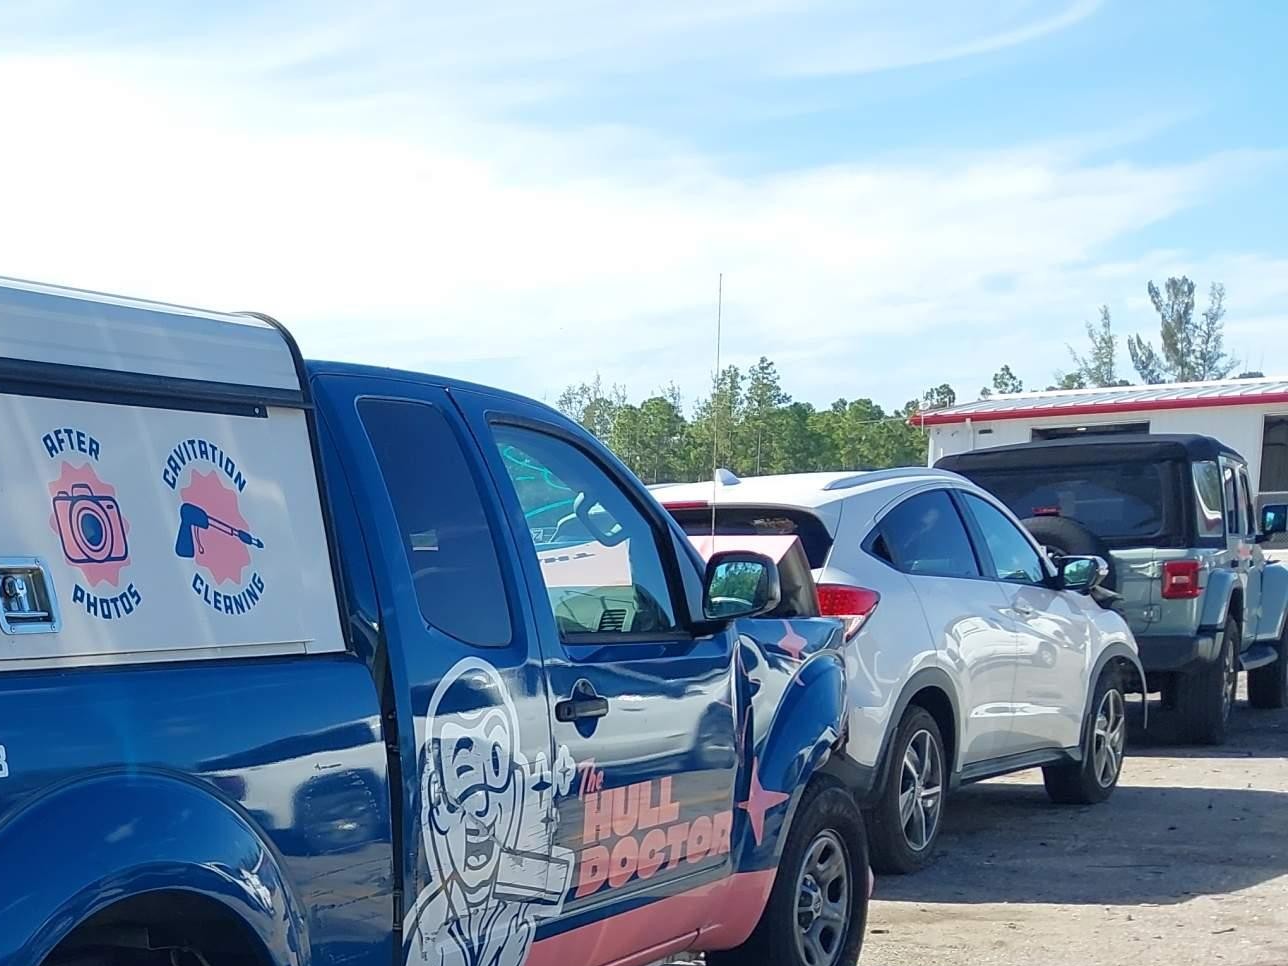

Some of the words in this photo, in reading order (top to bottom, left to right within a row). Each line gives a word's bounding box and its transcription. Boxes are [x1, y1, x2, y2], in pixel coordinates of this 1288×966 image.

[42, 427, 101, 461] AFTER
[162, 439, 248, 493] CAVITATION
[72, 583, 143, 620] PHOTOS
[191, 572, 266, 616] CLEANING
[578, 758, 605, 801] The
[583, 776, 680, 845] HULL
[574, 810, 733, 899] DOCTOR
